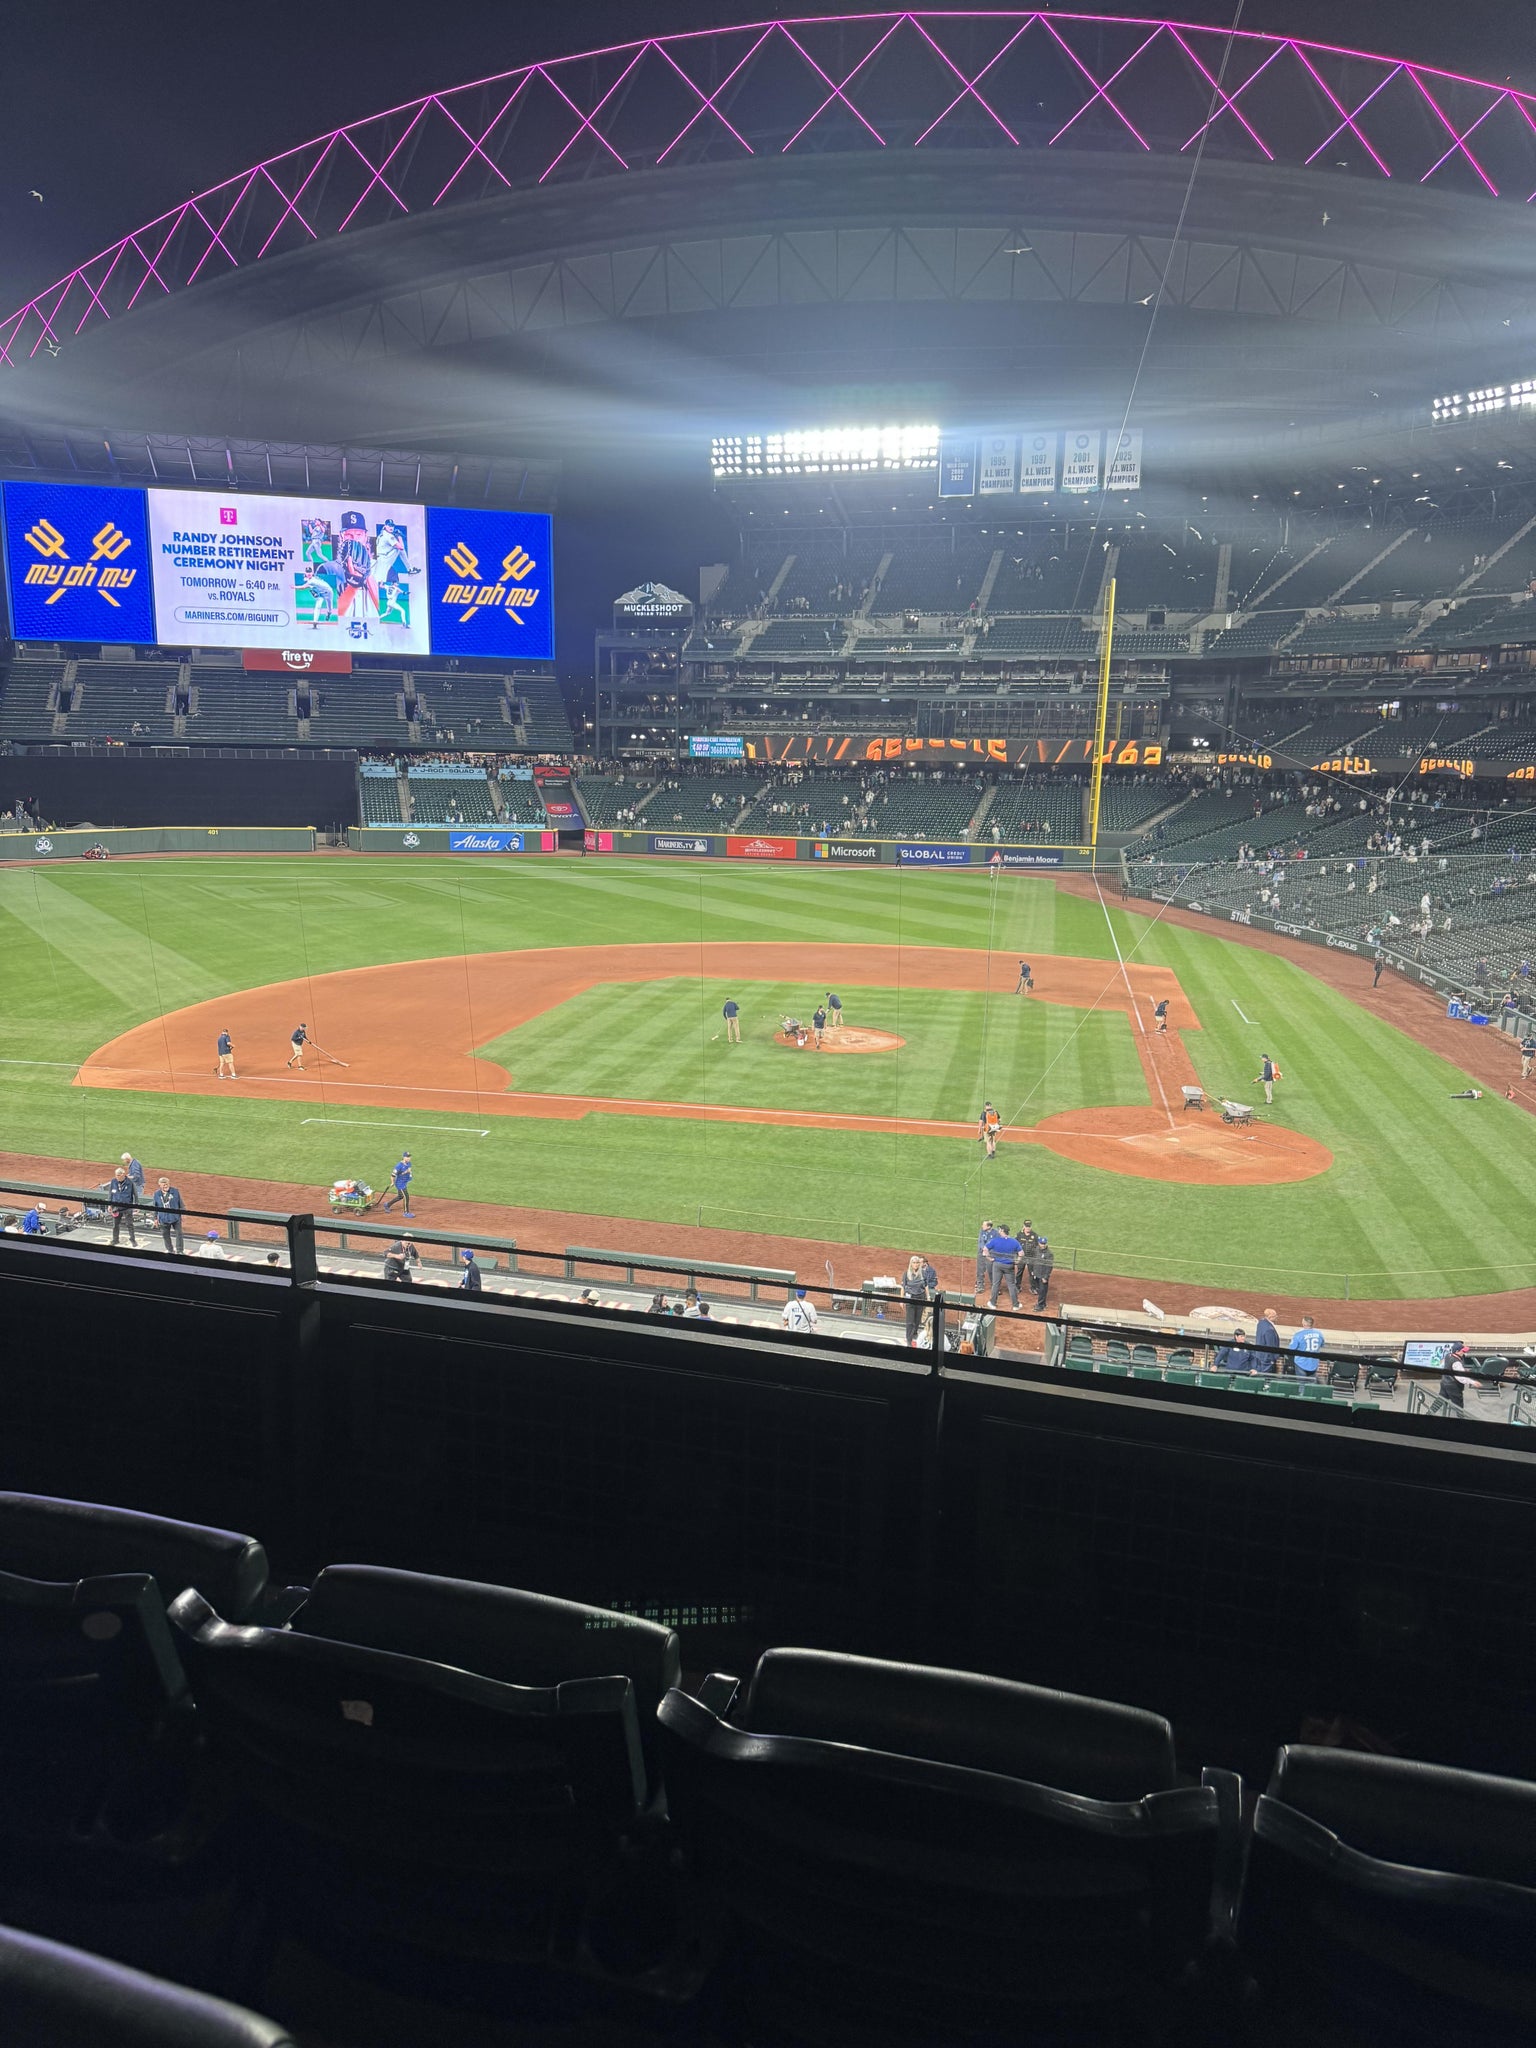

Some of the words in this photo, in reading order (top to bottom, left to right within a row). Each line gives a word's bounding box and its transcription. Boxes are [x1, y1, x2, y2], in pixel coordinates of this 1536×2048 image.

[1031, 455, 1046, 464] 1997
[1073, 453, 1090, 463] 2001
[995, 468, 1010, 477] WEST
[1036, 467, 1051, 475] WEST
[1078, 465, 1094, 473] WEST
[1121, 464, 1136, 472] WEST
[981, 479, 1013, 488] CHAMPIONS
[1021, 478, 1054, 487] CHAMPIONS
[1063, 476, 1097, 486] CHAMPIONS
[1106, 475, 1138, 484] CHAMPIONS
[173, 531, 217, 543] RANDY
[220, 534, 282, 547] JOHNSON
[162, 544, 216, 556] NUMBER
[219, 546, 294, 560] RETIREMENT
[173, 557, 244, 570] CEREMONY
[246, 560, 285, 572] NIGHT
[24, 564, 65, 585] my
[62, 562, 98, 586] oh
[97, 567, 137, 588] my
[180, 576, 237, 588] TOMORROW
[245, 580, 265, 590] 6:40
[267, 583, 280, 591] P.M.
[219, 591, 255, 602] ROYALS
[442, 584, 478, 604] my
[475, 582, 506, 605] oh
[505, 587, 540, 607] my
[623, 604, 683, 612] MUCKLESHOOT
[184, 610, 279, 622] MARINERS.COM/BIGUNIT
[349, 621, 368, 639] 51
[281, 650, 301, 661] fire
[302, 652, 314, 662] tv
[38, 840, 50, 848] 50
[453, 835, 500, 850] Alaska
[831, 846, 876, 857] Microsoft
[901, 850, 945, 859] GLOBAL
[1003, 854, 1035, 863] Benjamin
[1230, 910, 1251, 924] STIHL
[1274, 921, 1288, 933] Great
[1334, 939, 1357, 950] LEXUS
[795, 1314, 801, 1325] 7
[1305, 1338, 1319, 1351] 16
